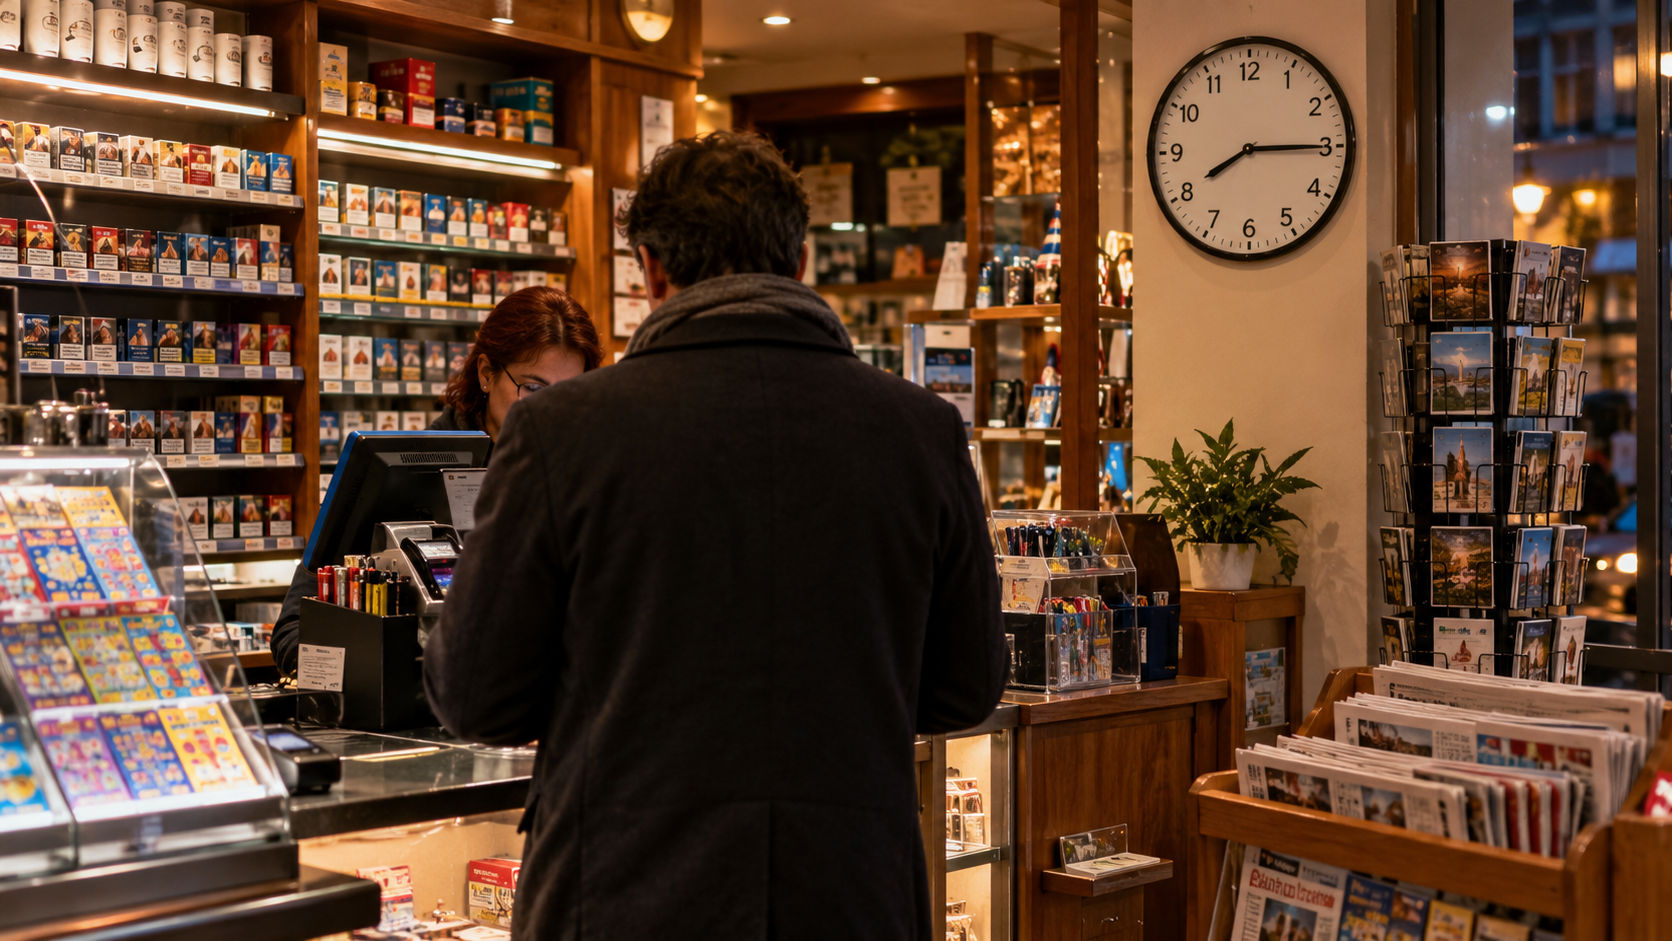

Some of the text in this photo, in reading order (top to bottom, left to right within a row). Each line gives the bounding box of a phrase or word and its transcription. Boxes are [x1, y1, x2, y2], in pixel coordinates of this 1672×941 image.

[1239, 61, 1260, 81] 12
[1283, 69, 1290, 89] 1
[1206, 74, 1221, 94] 11
[1179, 103, 1199, 123] 10
[1308, 97, 1322, 116] 2
[1170, 143, 1183, 162] 9
[1319, 137, 1332, 157] 3
[1180, 182, 1194, 201] 8
[1306, 178, 1321, 197] 4
[1208, 209, 1220, 229] 7
[1280, 207, 1293, 227] 5
[1242, 218, 1256, 238] 6
